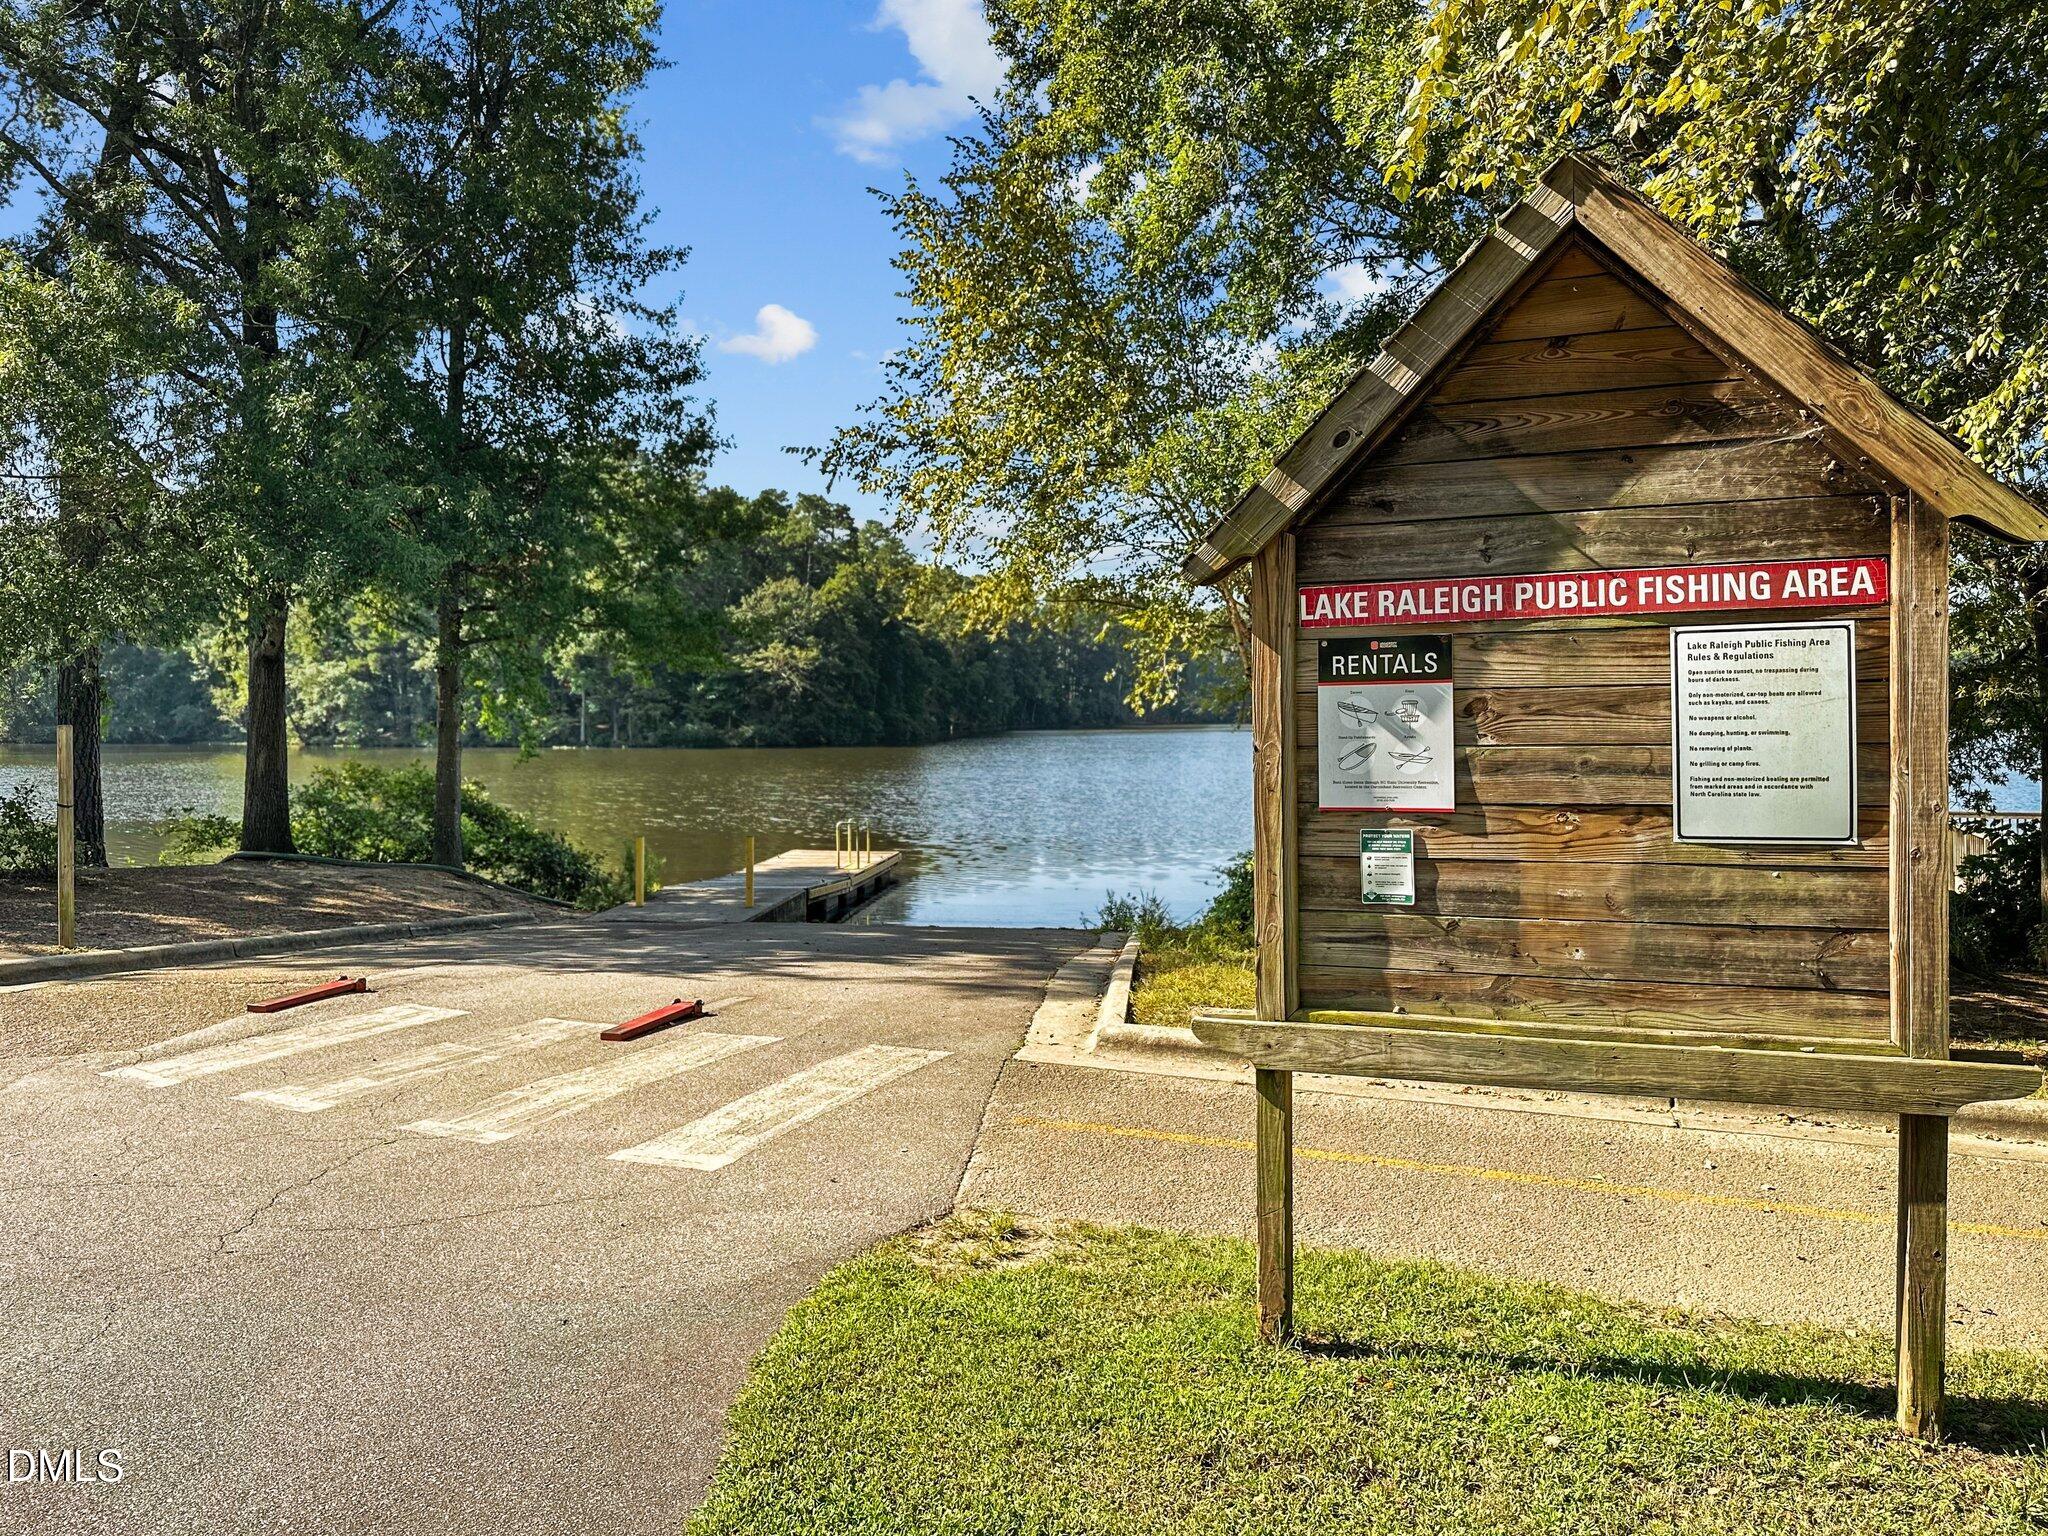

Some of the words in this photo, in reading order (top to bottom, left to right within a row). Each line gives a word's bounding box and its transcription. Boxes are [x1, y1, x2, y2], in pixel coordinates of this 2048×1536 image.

[1300, 591, 1369, 621] LAKE
[1378, 584, 1503, 617] RALEIGH
[1515, 577, 1628, 610] PUBLIC
[1638, 571, 1771, 605] FISHING
[1781, 565, 1876, 599] AREA
[1687, 642, 1707, 650] Lake
[1710, 641, 1742, 650] Raleigh
[1745, 640, 1773, 648] Public
[1775, 639, 1807, 648] Fishing
[1809, 638, 1830, 646] Area
[1332, 652, 1438, 676] RENTALS
[1687, 653, 1711, 661] Rules
[1723, 652, 1774, 661] Regulations
